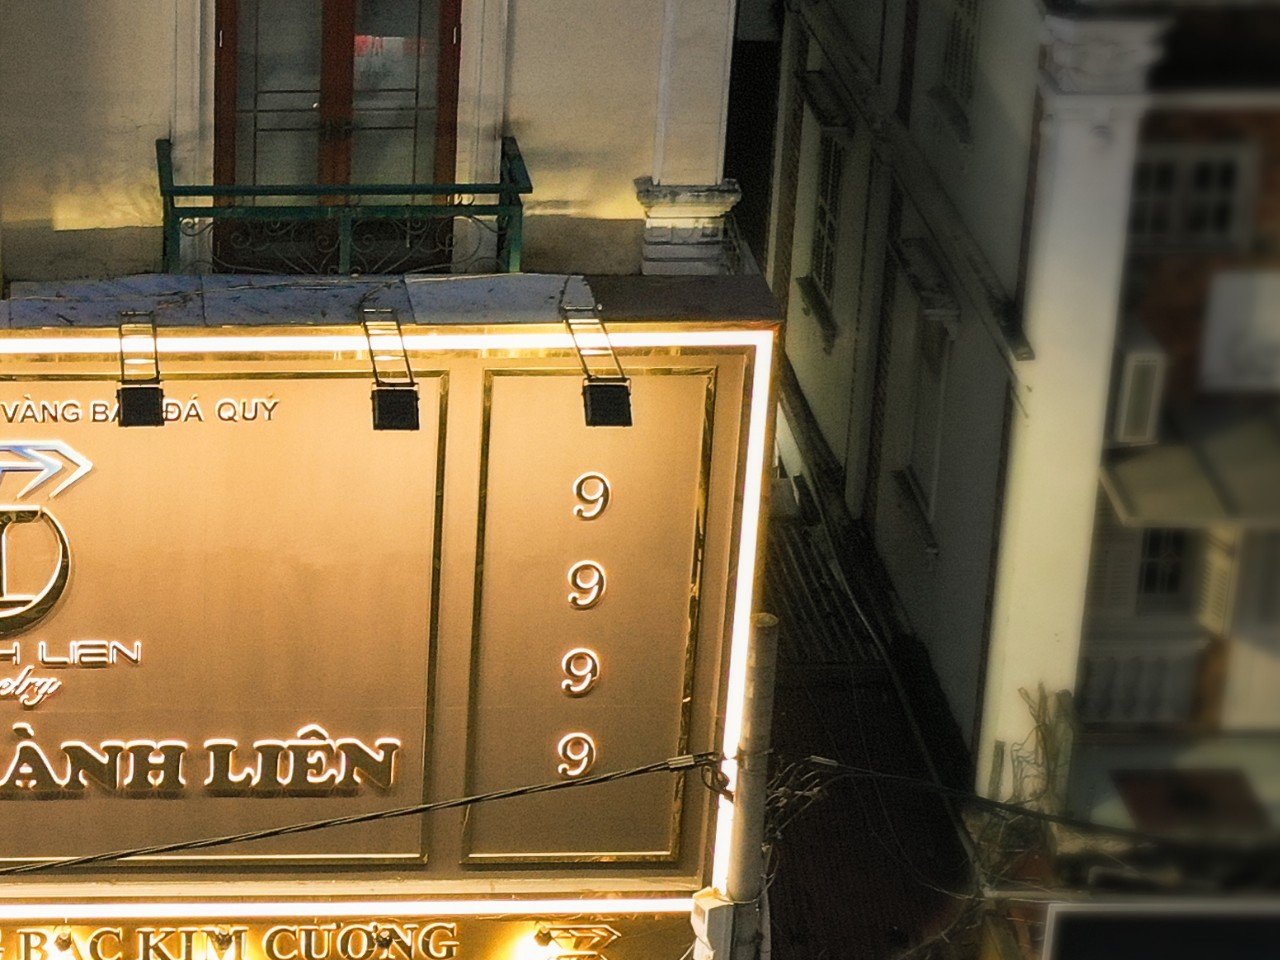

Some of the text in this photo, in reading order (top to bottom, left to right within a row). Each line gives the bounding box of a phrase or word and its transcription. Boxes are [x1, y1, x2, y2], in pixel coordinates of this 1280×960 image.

[0, 394, 82, 423] VÀNG
[216, 393, 280, 422] QUÝ
[37, 640, 142, 666] LIEN
[203, 723, 402, 793] LIÊN
